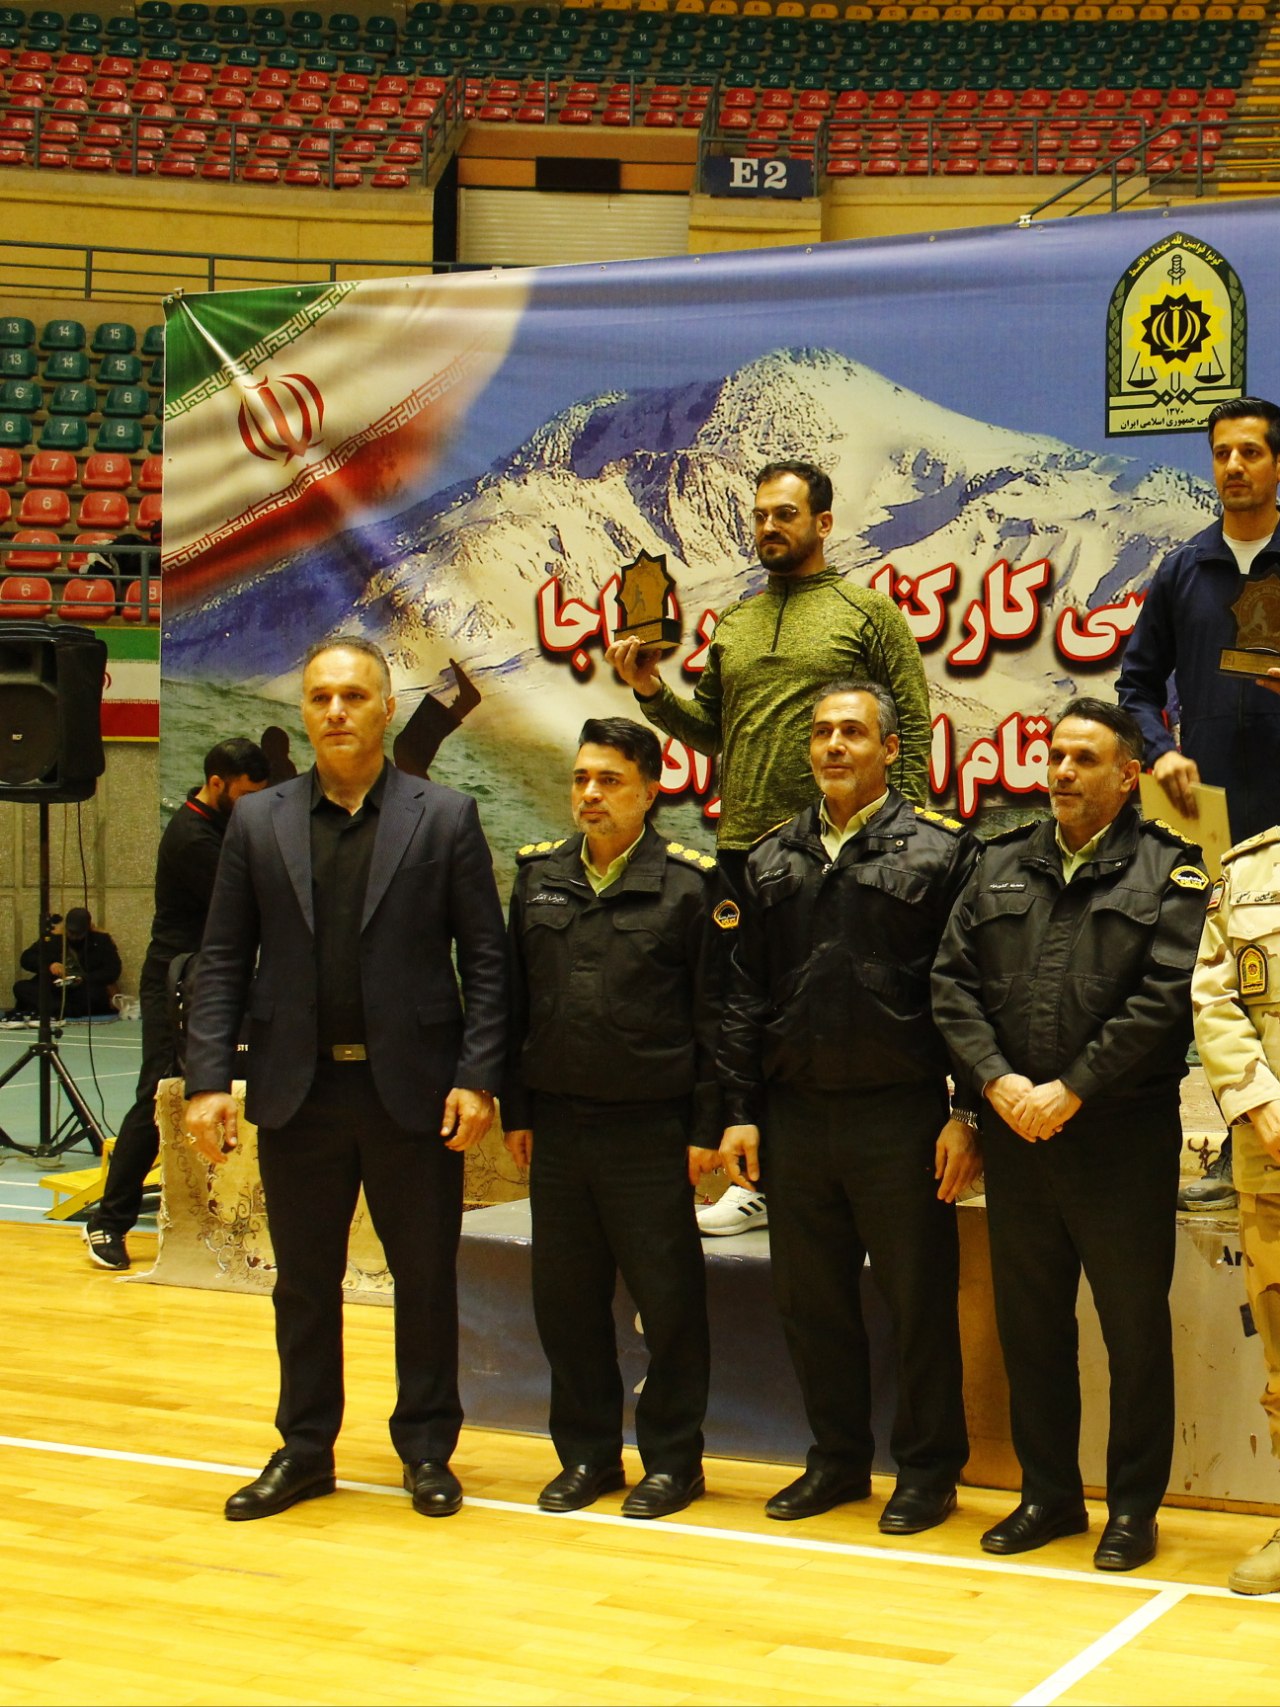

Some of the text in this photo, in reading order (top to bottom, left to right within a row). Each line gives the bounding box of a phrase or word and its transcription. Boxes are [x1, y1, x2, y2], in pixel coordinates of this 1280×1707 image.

[154, 5, 160, 13] 1
[5, 12, 12, 21] 3
[228, 10, 234, 18] 3
[265, 12, 272, 20] 4
[43, 15, 49, 24] 4
[82, 18, 89, 27] 5
[157, 24, 163, 33] 7
[417, 23, 424, 31] 8
[232, 29, 239, 37] 9
[266, 31, 275, 40] 10
[303, 33, 310, 41] 11
[81, 39, 88, 48] 4
[340, 36, 348, 45] 12
[376, 39, 384, 47] 13
[162, 46, 169, 54] 6
[414, 41, 422, 50] 14
[202, 48, 208, 57] 7
[241, 50, 248, 60] 8
[280, 53, 286, 62] 9
[317, 56, 326, 65] 10
[71, 58, 79, 68] 4
[357, 59, 365, 68] 11
[397, 61, 406, 70] 12
[434, 62, 443, 71] 13
[192, 68, 199, 77] 7
[232, 71, 239, 80] 8
[272, 73, 278, 82] 9
[309, 75, 319, 85] 10
[348, 79, 356, 87] 11
[388, 81, 398, 90] 12
[265, 95, 272, 104] 9
[729, 157, 788, 190] E2
[7, 323, 19, 333] 13
[59, 326, 70, 336] 14
[110, 328, 121, 339] 15
[10, 354, 22, 365] 13
[62, 357, 74, 368] 14
[115, 360, 126, 371] 15
[15, 387, 25, 399] 6
[70, 389, 79, 401] 7
[124, 392, 132, 403] 8
[1165, 407, 1185, 417] ۱۳۷۰
[1120, 418, 1141, 430] ایران
[1140, 417, 1166, 429] اسلامی
[1165, 416, 1197, 428] جمهوری
[5, 421, 14, 433] 6
[61, 423, 70, 435] 7
[117, 425, 125, 437] 8
[50, 458, 59, 471] 7
[105, 460, 114, 473] 8
[42, 496, 52, 510] 6
[102, 499, 111, 512] 7
[21, 583, 31, 596] 6
[85, 585, 95, 599] 7
[870, 558, 1051, 666] کارکنا
[957, 712, 1051, 819] قام
